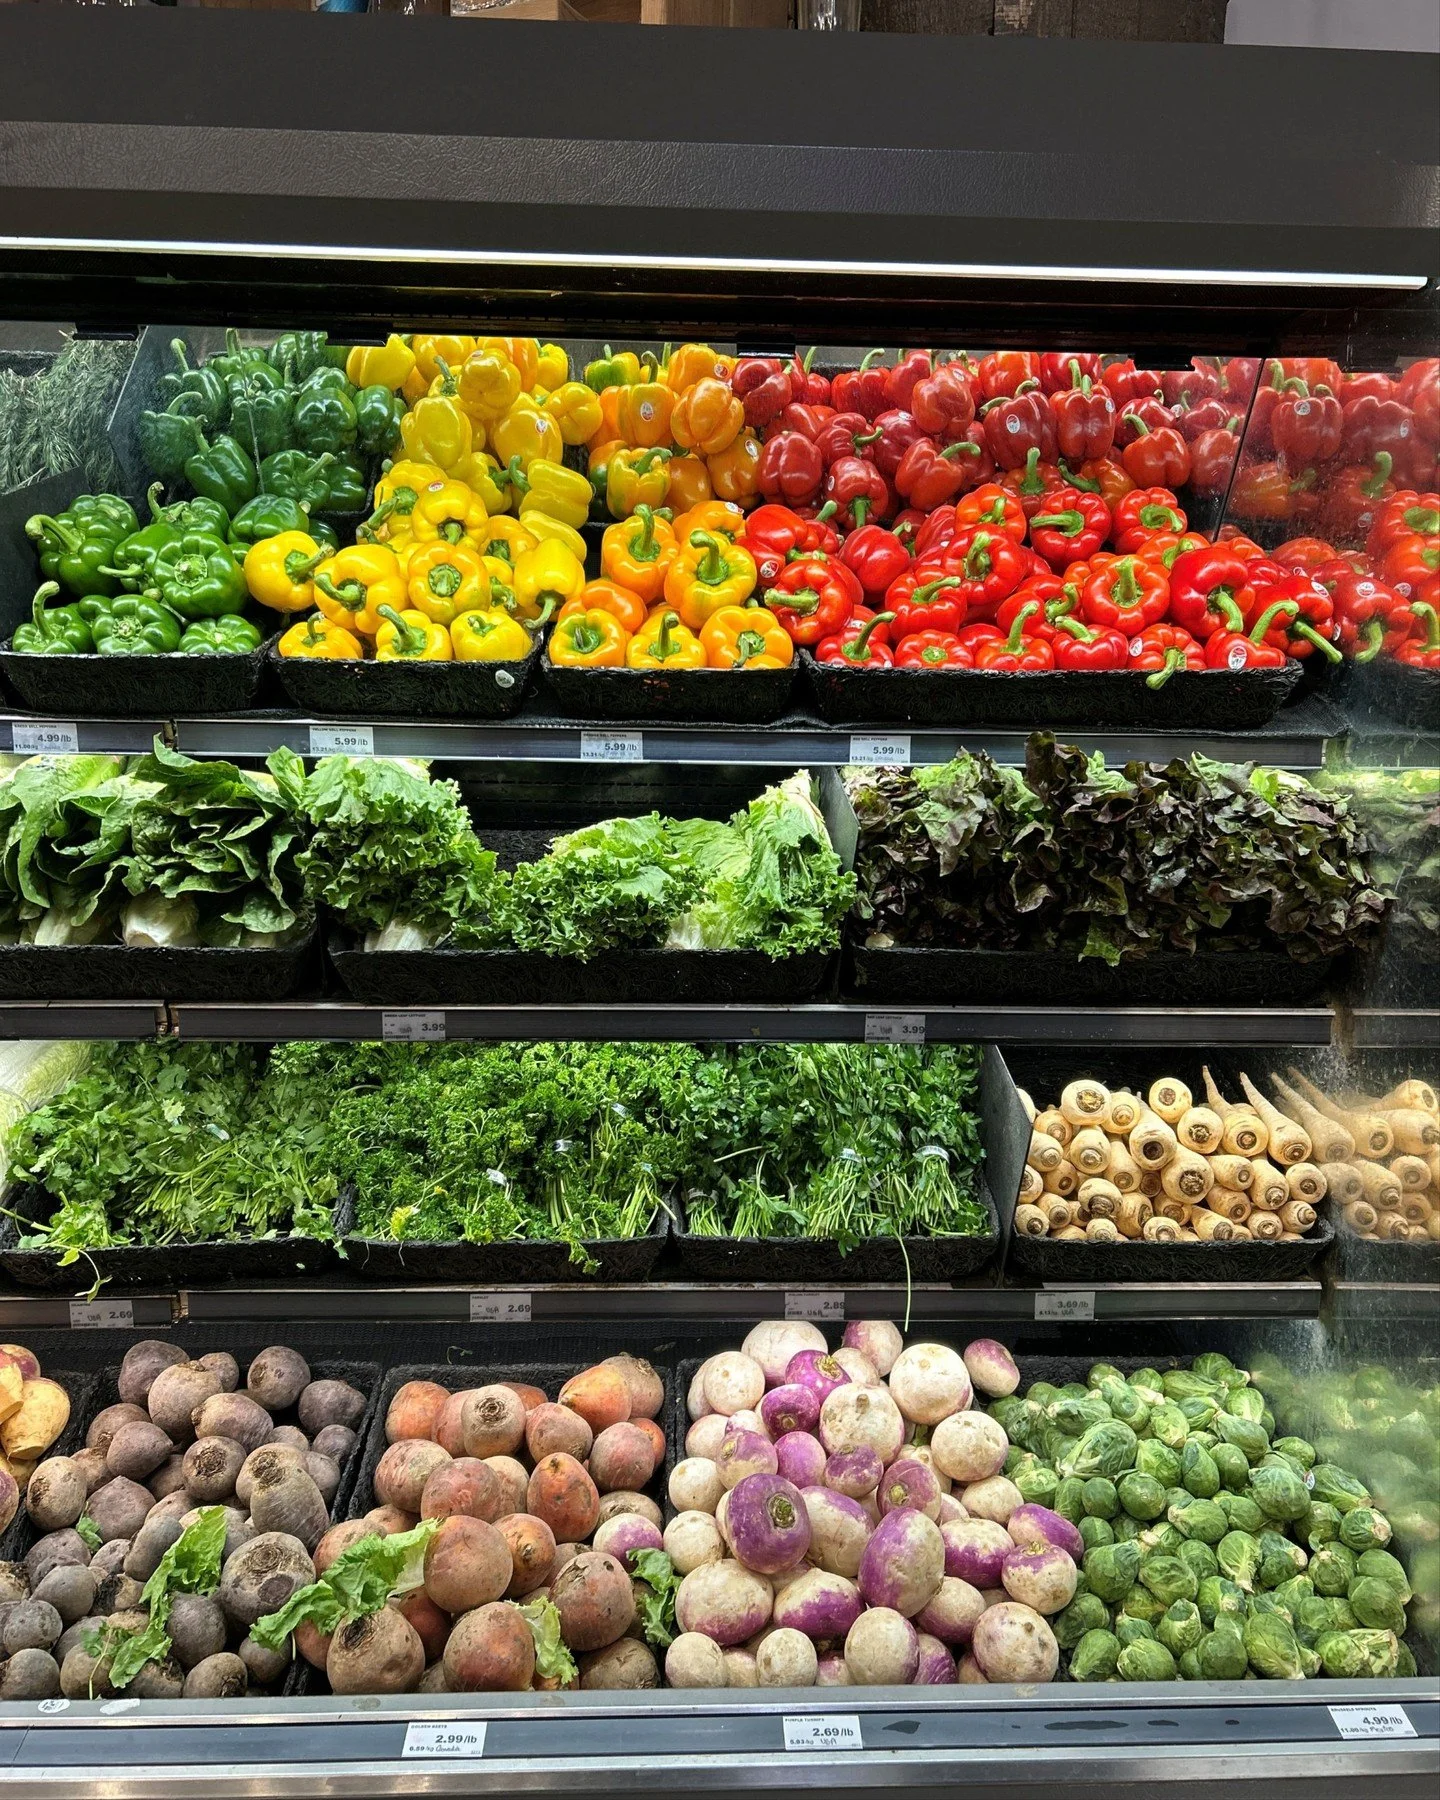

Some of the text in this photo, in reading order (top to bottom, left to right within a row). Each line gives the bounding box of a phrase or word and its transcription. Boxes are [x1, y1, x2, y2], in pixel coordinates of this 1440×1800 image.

[37, 734, 72, 743] 4.99/lb
[334, 737, 369, 746] 5.99/lb
[604, 742, 638, 751] 5.99/lb
[872, 746, 905, 755] 5.99/lb
[421, 1023, 446, 1032] 3.99
[902, 1025, 926, 1034] 3.99
[508, 1304, 531, 1313] 2.69
[108, 1310, 133, 1319] 2.69
[1362, 1716, 1404, 1726] 4.99/lb
[812, 1727, 854, 1737] 2.69/lb
[434, 1734, 478, 1744] 2.99/lb
